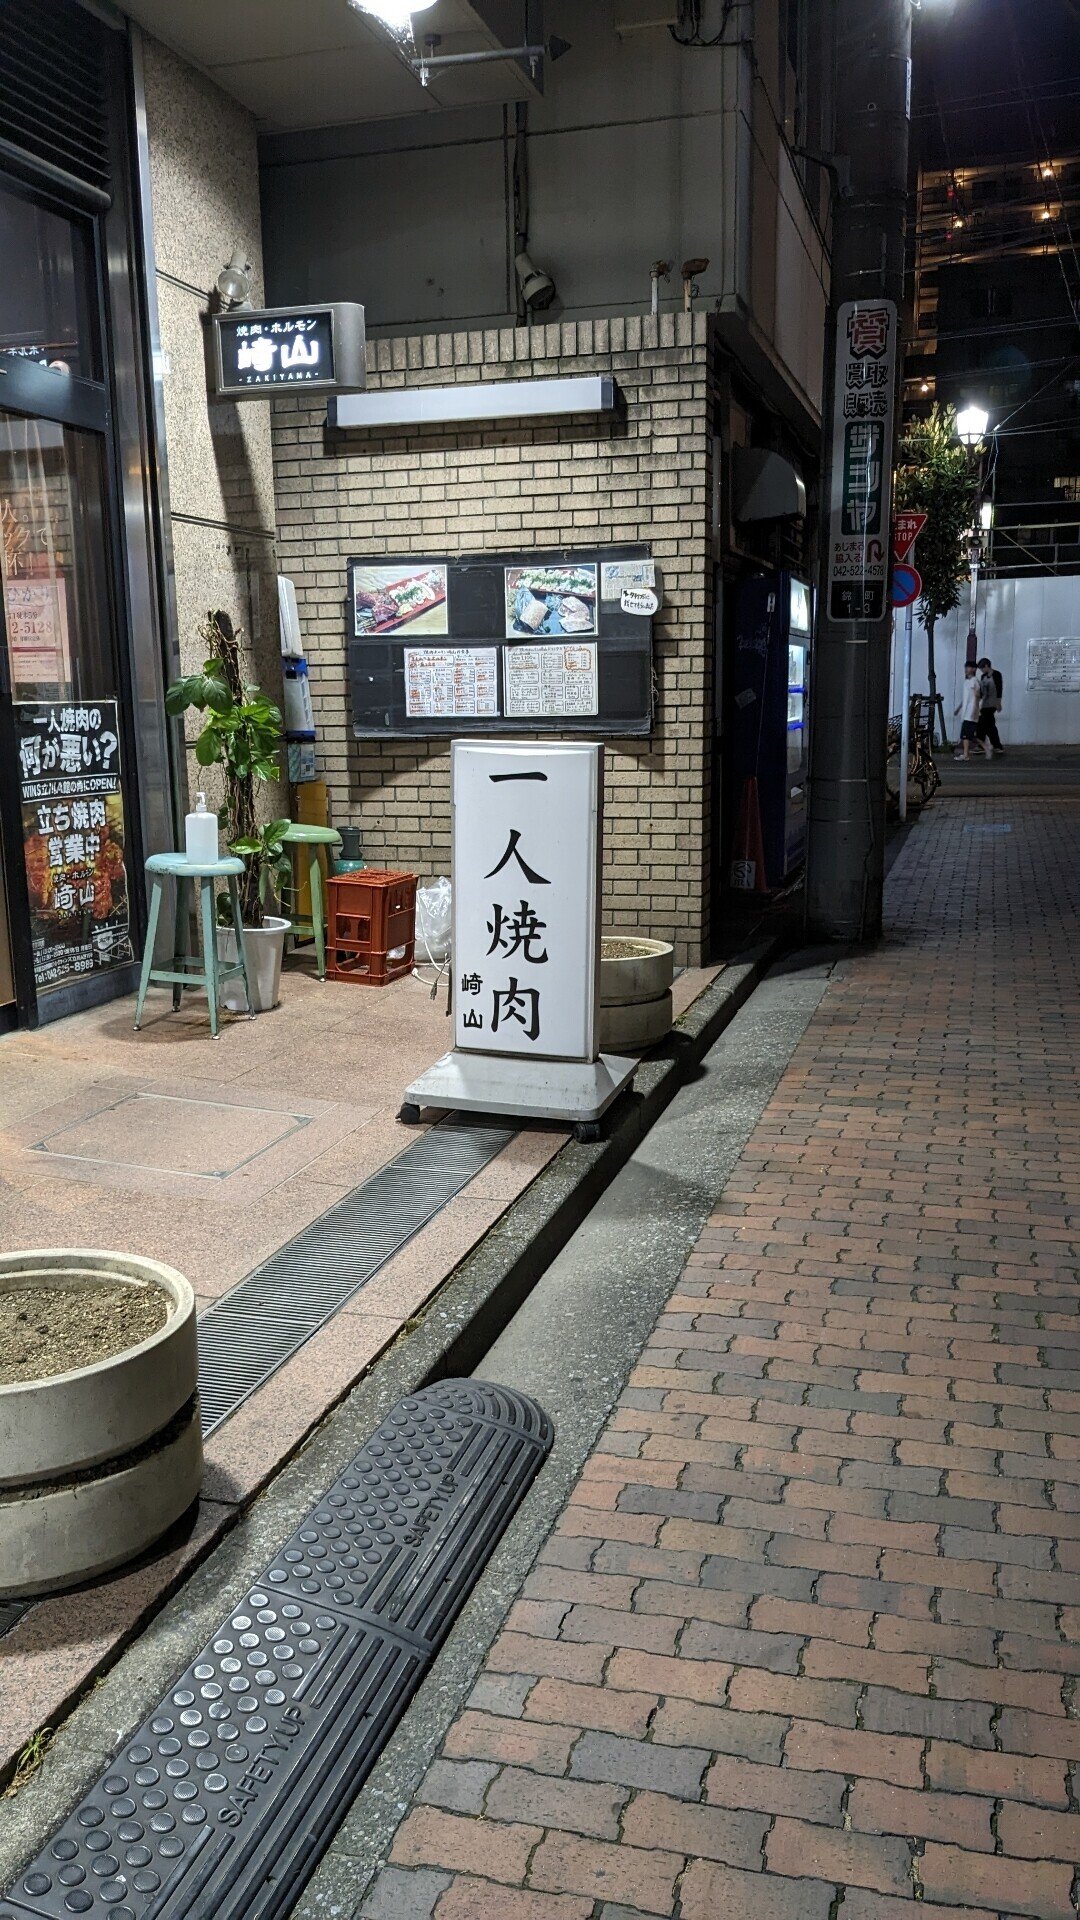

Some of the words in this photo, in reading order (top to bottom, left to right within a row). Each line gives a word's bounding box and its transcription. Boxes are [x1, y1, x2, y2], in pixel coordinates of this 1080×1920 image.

[236, 319, 317, 337] 焼肉・ホルモン
[846, 361, 888, 389] 買取
[843, 391, 887, 418] 販売
[33, 707, 102, 733] 一人焼肉の
[37, 799, 106, 835] 立ち焼肉
[48, 832, 100, 868] 営業中
[483, 770, 552, 1042] 一人焼肉
